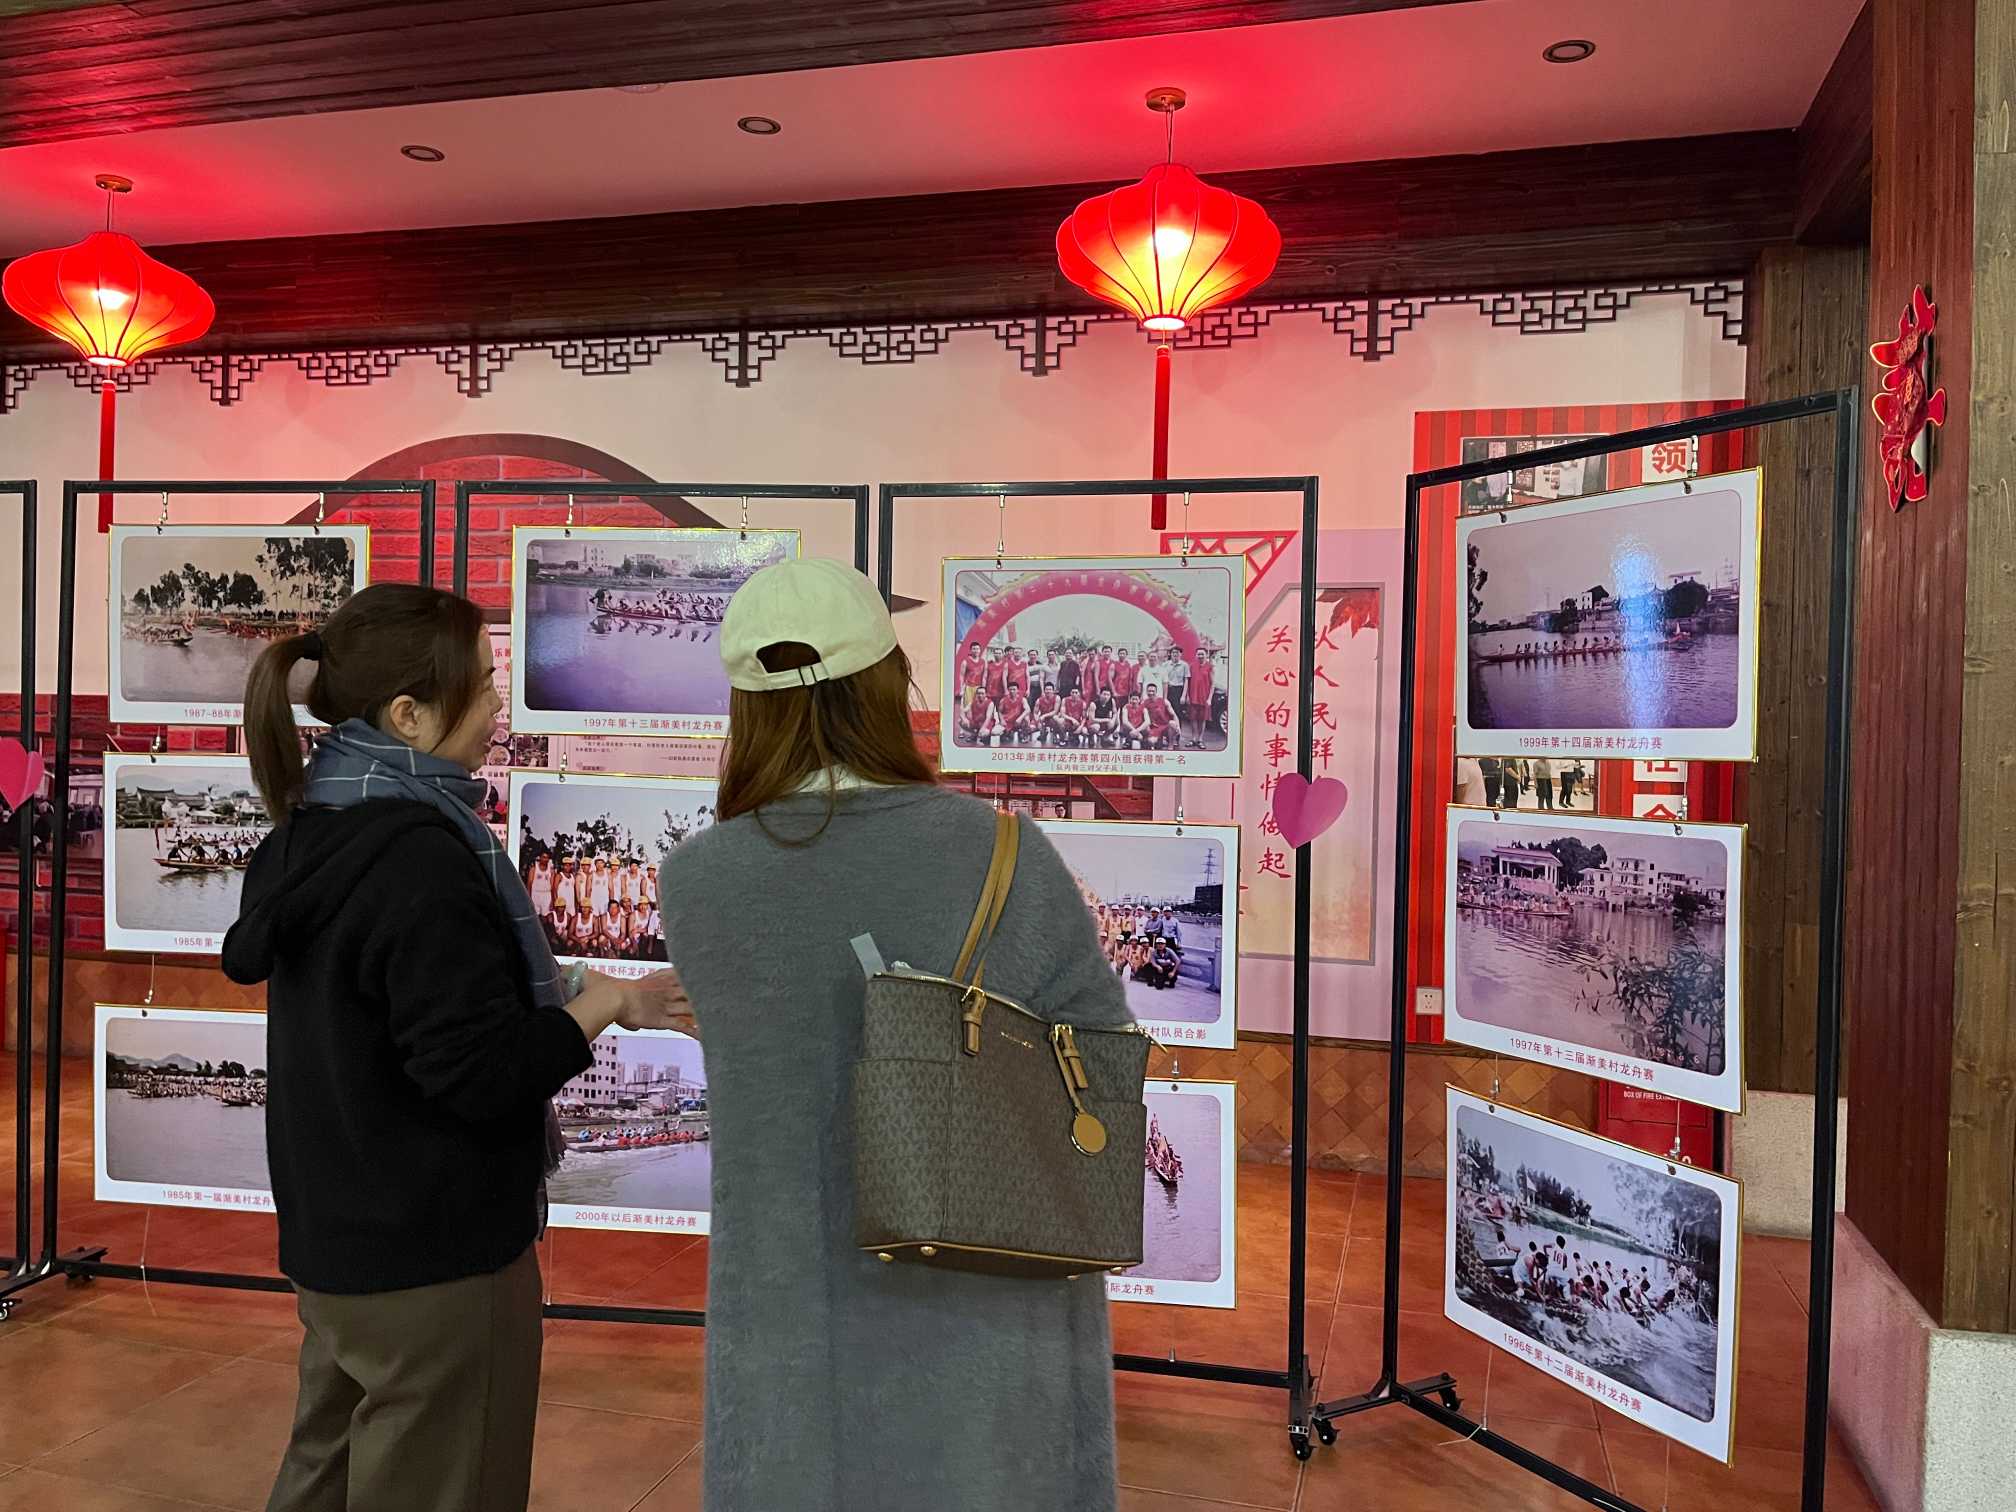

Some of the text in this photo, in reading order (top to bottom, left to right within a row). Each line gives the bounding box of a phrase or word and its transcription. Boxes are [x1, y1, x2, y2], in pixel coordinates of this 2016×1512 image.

[1652, 441, 1687, 474] 领
[584, 718, 723, 731] 1997年第十三届渐美村龙舟赛
[1519, 736, 1664, 750] 1999年第十四届渐美村龙舟赛
[1145, 1025, 1207, 1041] 村队员合影
[1510, 1038, 1654, 1082] 1997年第十三届渐美村龙舟赛
[575, 1211, 697, 1227] 2000年以后渐美村龙舟赛
[1104, 1280, 1154, 1296] 际龙舟赛
[1504, 1332, 1643, 1413] 1996年第十二届渐美村龙舟赛
